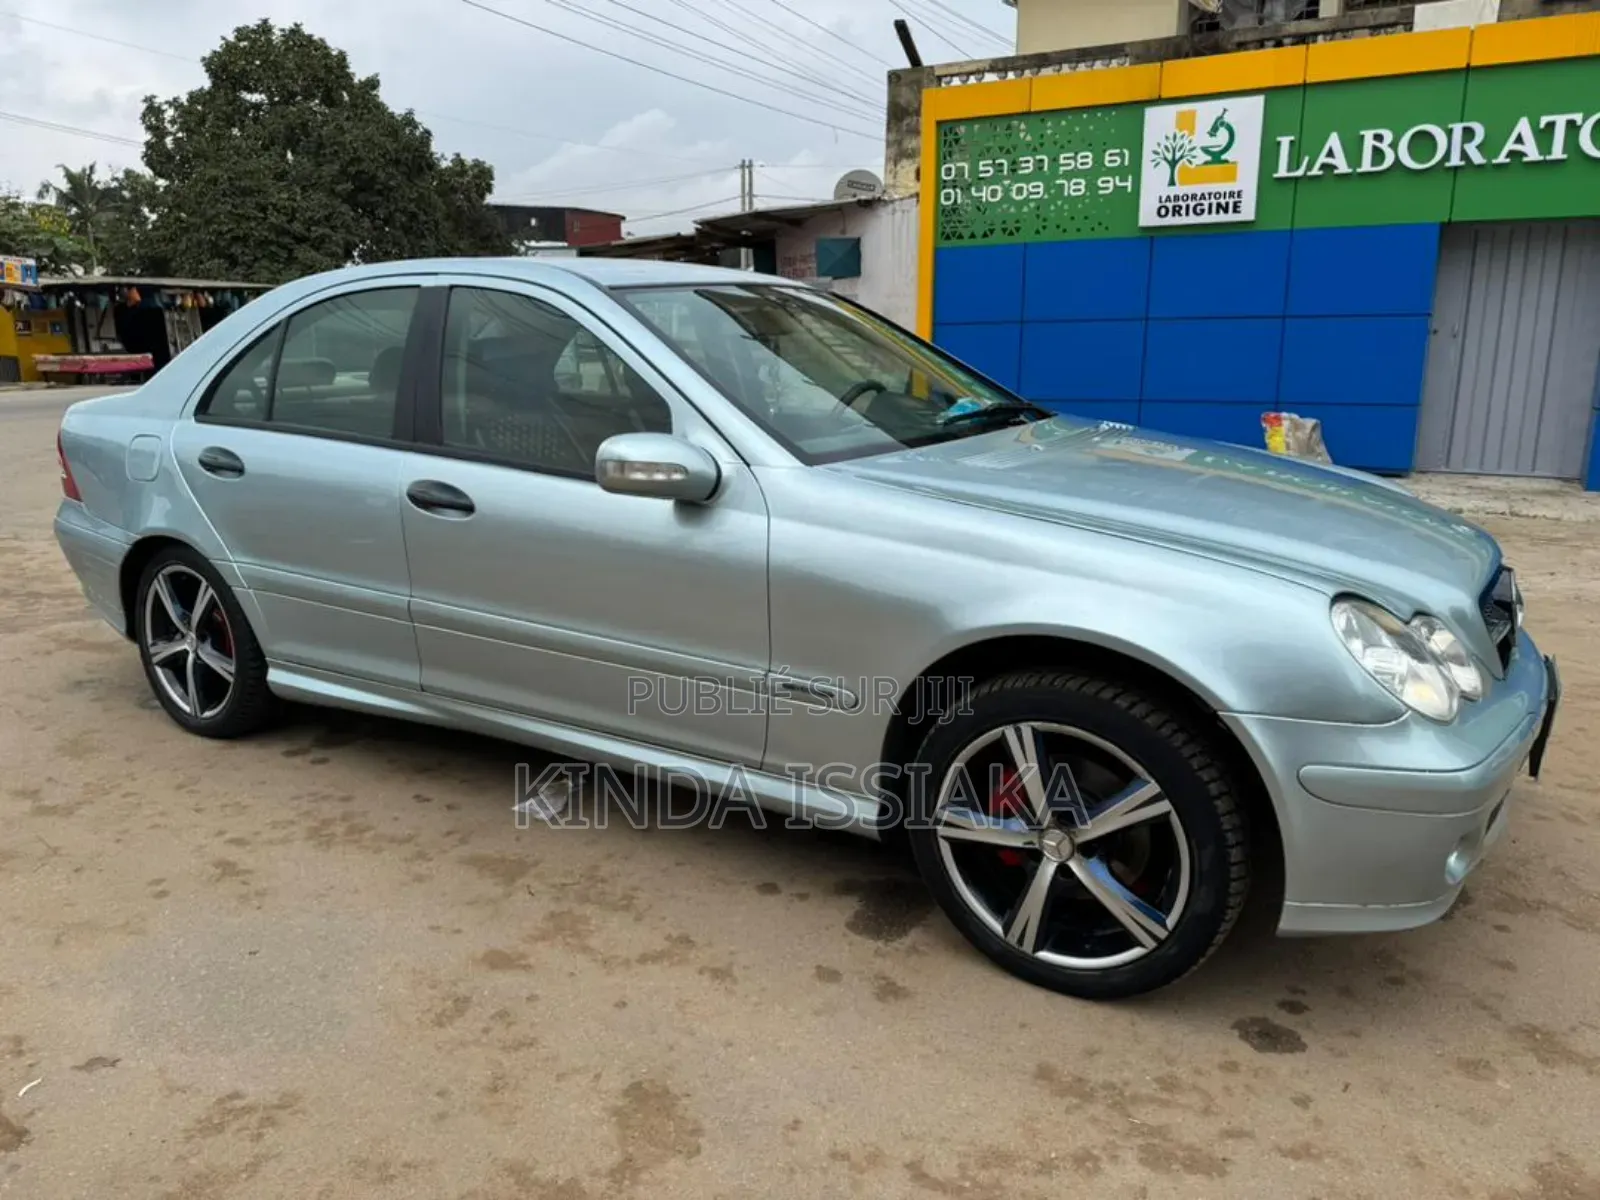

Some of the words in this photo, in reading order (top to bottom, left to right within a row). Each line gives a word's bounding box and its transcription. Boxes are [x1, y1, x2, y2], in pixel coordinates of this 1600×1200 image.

[941, 162, 969, 180] 07
[978, 158, 1008, 178] 57
[1018, 154, 1049, 174] 37
[1059, 151, 1093, 171] 58
[1104, 148, 1130, 167] 61
[940, 188, 962, 205] 01
[971, 185, 1002, 203] 40
[1012, 181, 1044, 200] 09
[1055, 178, 1086, 197] 78
[1097, 174, 1132, 195] 94
[1158, 189, 1243, 204] LABORATOIRE
[1156, 200, 1243, 218] ORIGINE
